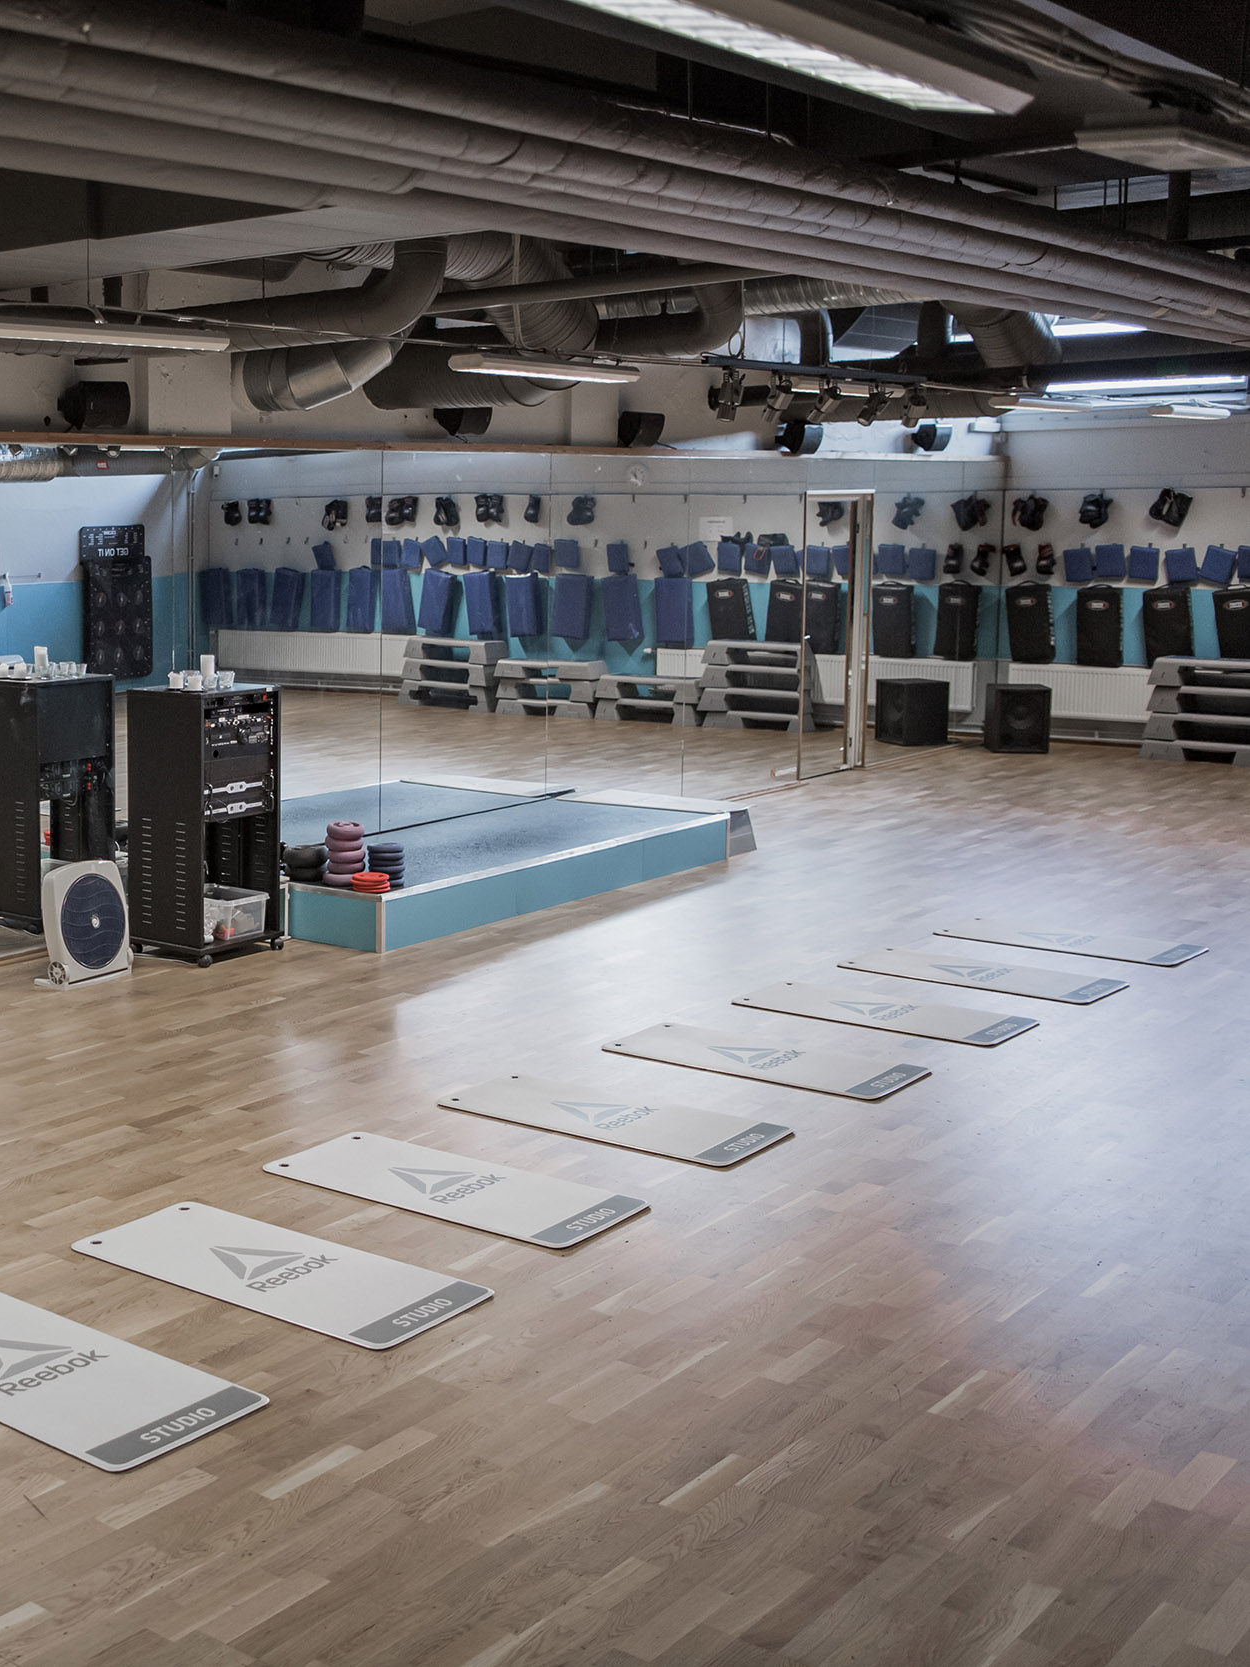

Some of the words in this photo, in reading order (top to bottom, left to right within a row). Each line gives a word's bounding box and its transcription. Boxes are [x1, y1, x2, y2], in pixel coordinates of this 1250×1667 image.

[751, 1049, 806, 1070] Reebok
[869, 1072, 907, 1088] STUDIO
[594, 1105, 659, 1131] Reebok
[723, 1132, 765, 1152] STUDIO
[429, 1173, 506, 1204] Reebok
[566, 1207, 616, 1231] STUDIO
[245, 1254, 338, 1292] Reebok
[392, 1298, 452, 1327] STUDIO
[140, 1407, 216, 1444] STUDIO
